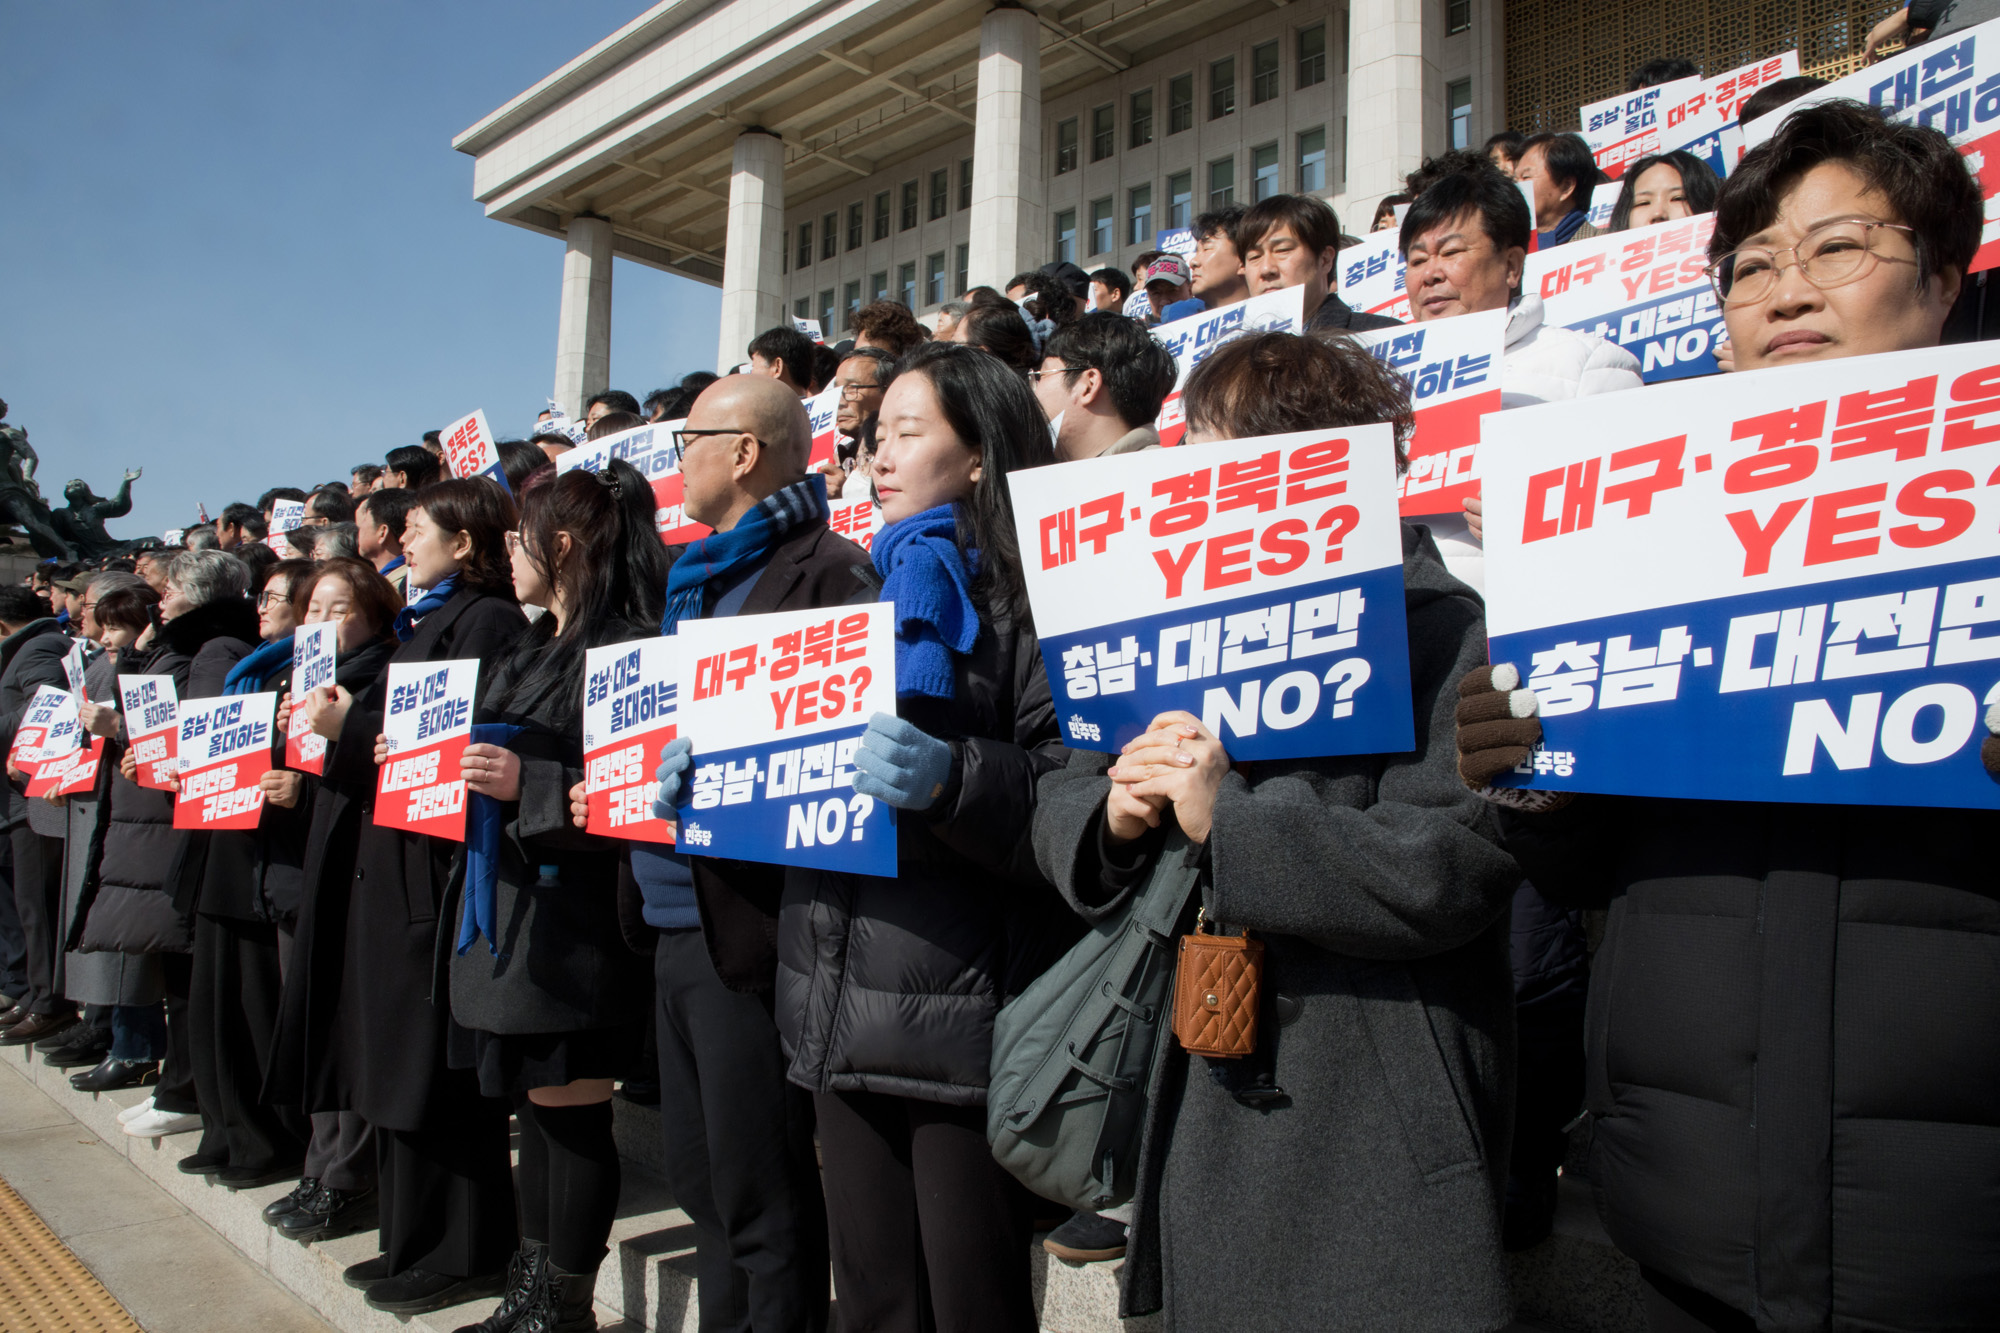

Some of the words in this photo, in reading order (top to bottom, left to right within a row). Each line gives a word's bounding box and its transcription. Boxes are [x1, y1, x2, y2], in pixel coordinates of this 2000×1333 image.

[1588, 88, 1661, 132] 충남·대전
[1667, 58, 1783, 129] 대구·경북은
[1624, 108, 1657, 135] 홀대
[1345, 248, 1406, 289] 충남·
[1621, 254, 1709, 301] YES
[1165, 304, 1247, 358] 남·대전
[1643, 322, 1730, 373] NO?
[572, 428, 655, 473] 남·대전
[1397, 443, 1481, 499] 한다
[828, 500, 873, 535] 북은
[1039, 438, 1351, 572] 대구·경북은
[1724, 456, 2000, 579] YES
[1151, 504, 1361, 600] YES?
[692, 612, 870, 702] 대구·경북은
[1062, 587, 1365, 700] 충남·대전만
[124, 680, 158, 712] 충남·대전
[390, 667, 450, 716] 충남·대전
[587, 647, 642, 708] 충남·대전
[769, 665, 873, 731] YES?
[1202, 657, 1372, 740] NO?
[143, 700, 177, 729] 홀대하는
[181, 699, 245, 742] 충남·대전
[416, 696, 470, 741] 홀대하는
[610, 679, 678, 735] 홀대하는
[1783, 682, 2000, 776] NO
[208, 720, 268, 759] 홀대하는
[1068, 721, 1101, 742] 민주당
[151, 756, 178, 785] 규탄한
[202, 783, 267, 824] 규탄한다
[406, 778, 466, 823] 규탄한다
[608, 780, 662, 828] 규탄한
[785, 792, 875, 850] NO?
[684, 828, 713, 847] 민주당
